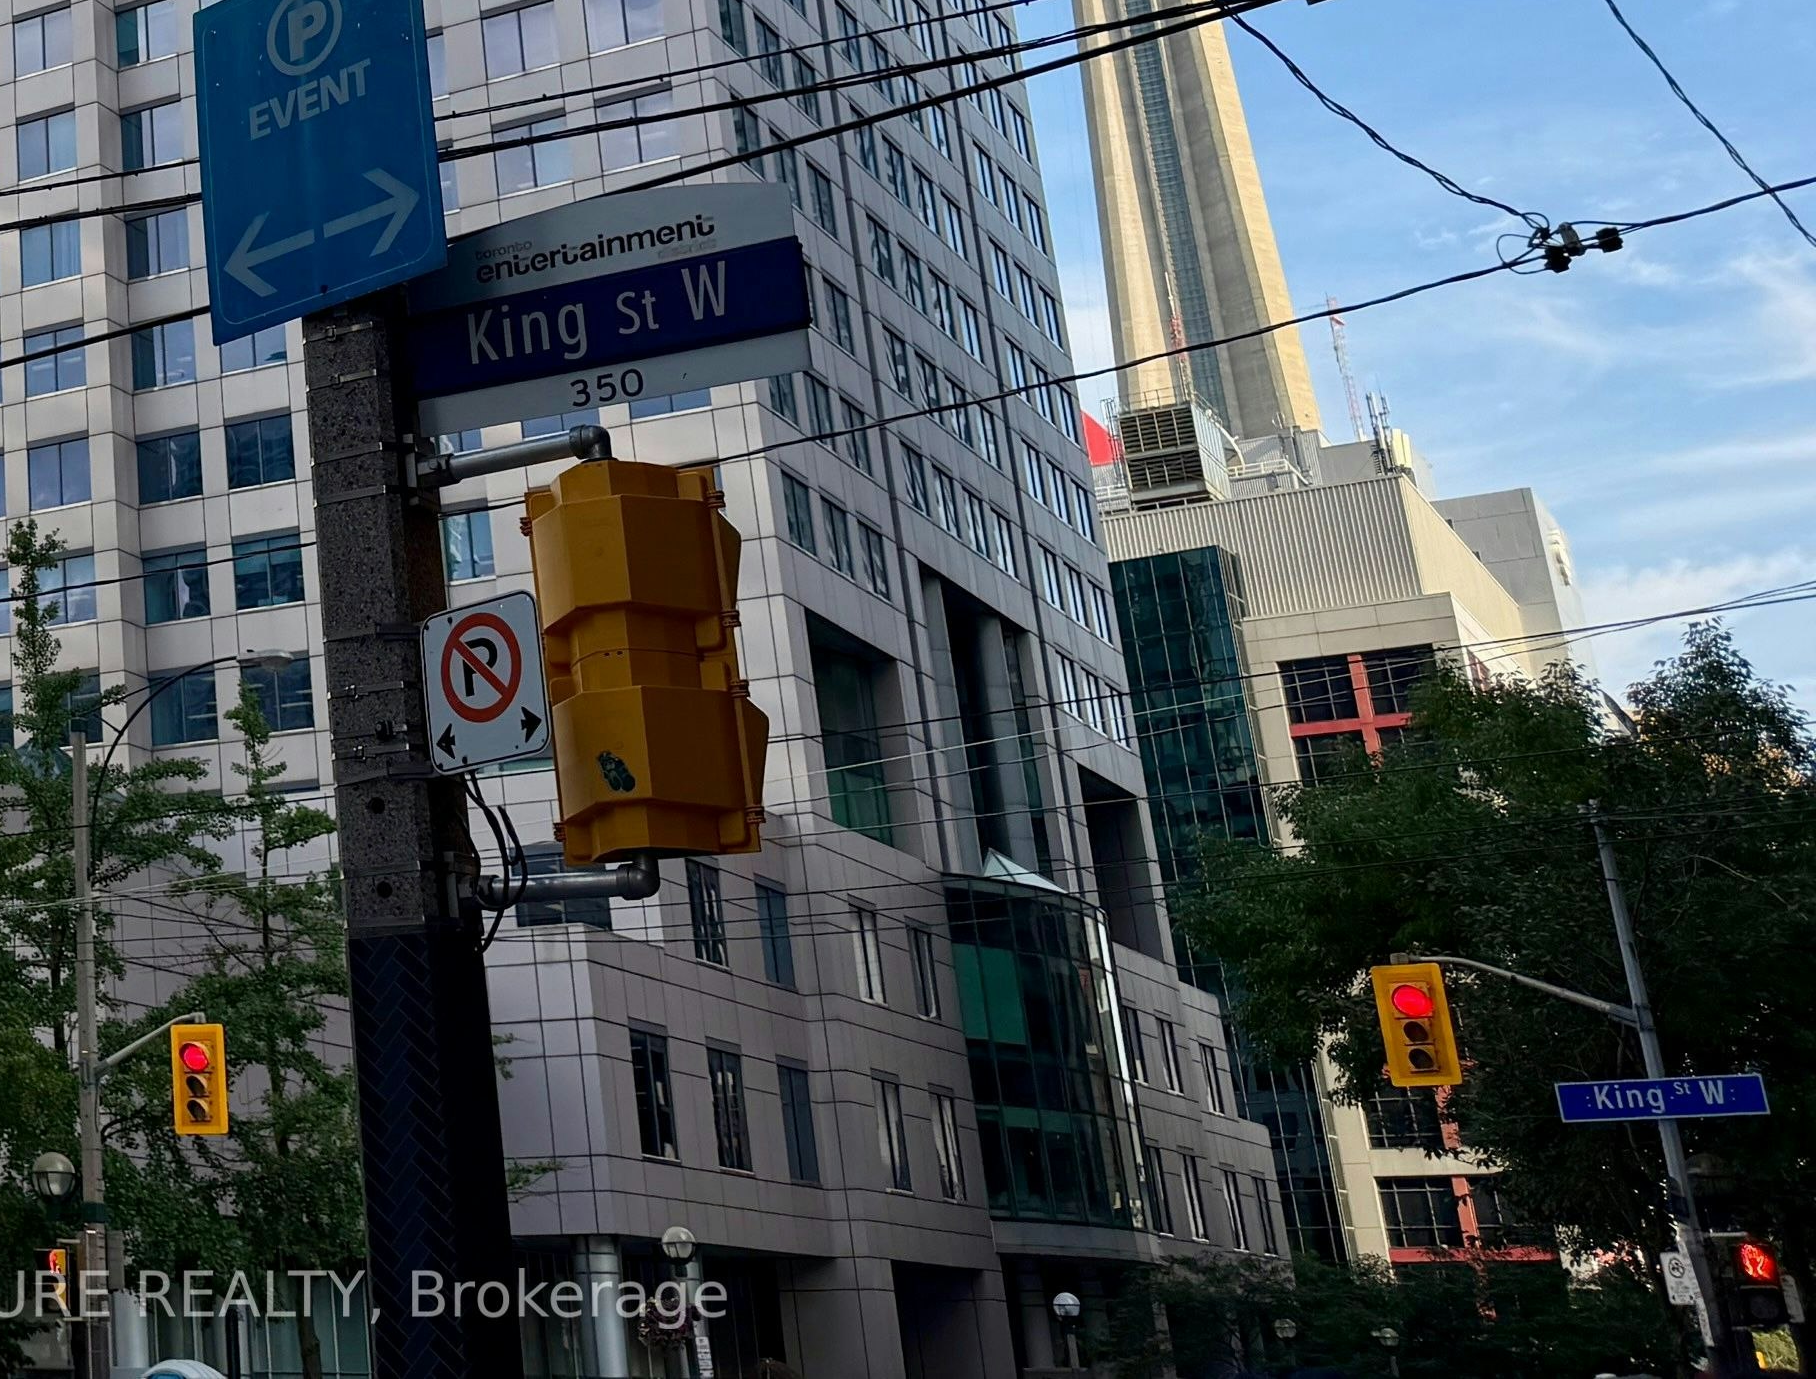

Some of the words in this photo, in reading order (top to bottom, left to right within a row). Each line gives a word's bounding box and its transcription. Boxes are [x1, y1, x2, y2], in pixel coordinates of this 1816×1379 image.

[288, 0, 327, 62] P
[249, 57, 372, 141] EVENT
[475, 240, 533, 261] toronto
[476, 214, 715, 284] entertainment
[468, 302, 588, 364] King
[616, 290, 660, 334] St
[681, 260, 726, 321] W
[570, 368, 645, 407] 350
[1593, 1084, 1666, 1114] King
[1673, 1081, 1692, 1096] St
[1698, 1080, 1725, 1105] W
